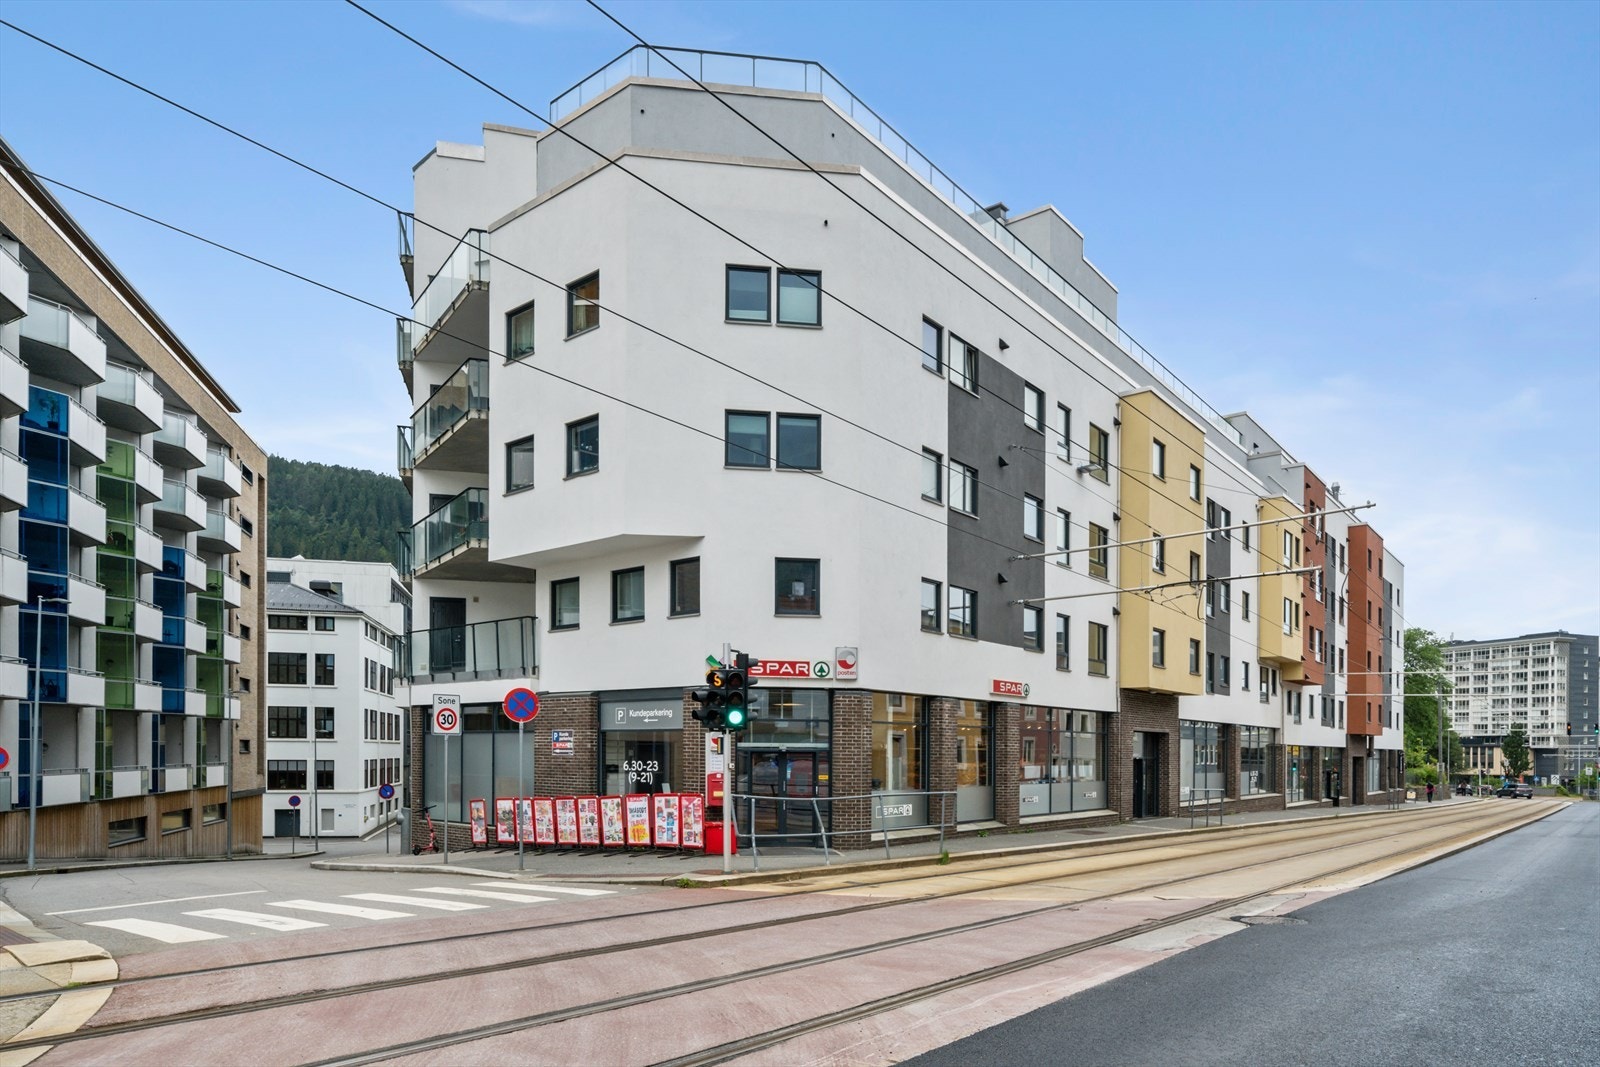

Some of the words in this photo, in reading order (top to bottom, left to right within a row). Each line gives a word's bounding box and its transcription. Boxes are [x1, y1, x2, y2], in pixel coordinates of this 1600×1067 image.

[750, 661, 809, 674] SPAR
[837, 669, 857, 677] posten
[1000, 682, 1022, 693] SPAR
[438, 696, 456, 705] Sone
[629, 708, 673, 718] Kundeparkering
[440, 713, 454, 725] 30
[623, 760, 659, 772] 6.30-23
[628, 771, 653, 785] (9-21)
[883, 806, 904, 816] SPAR
